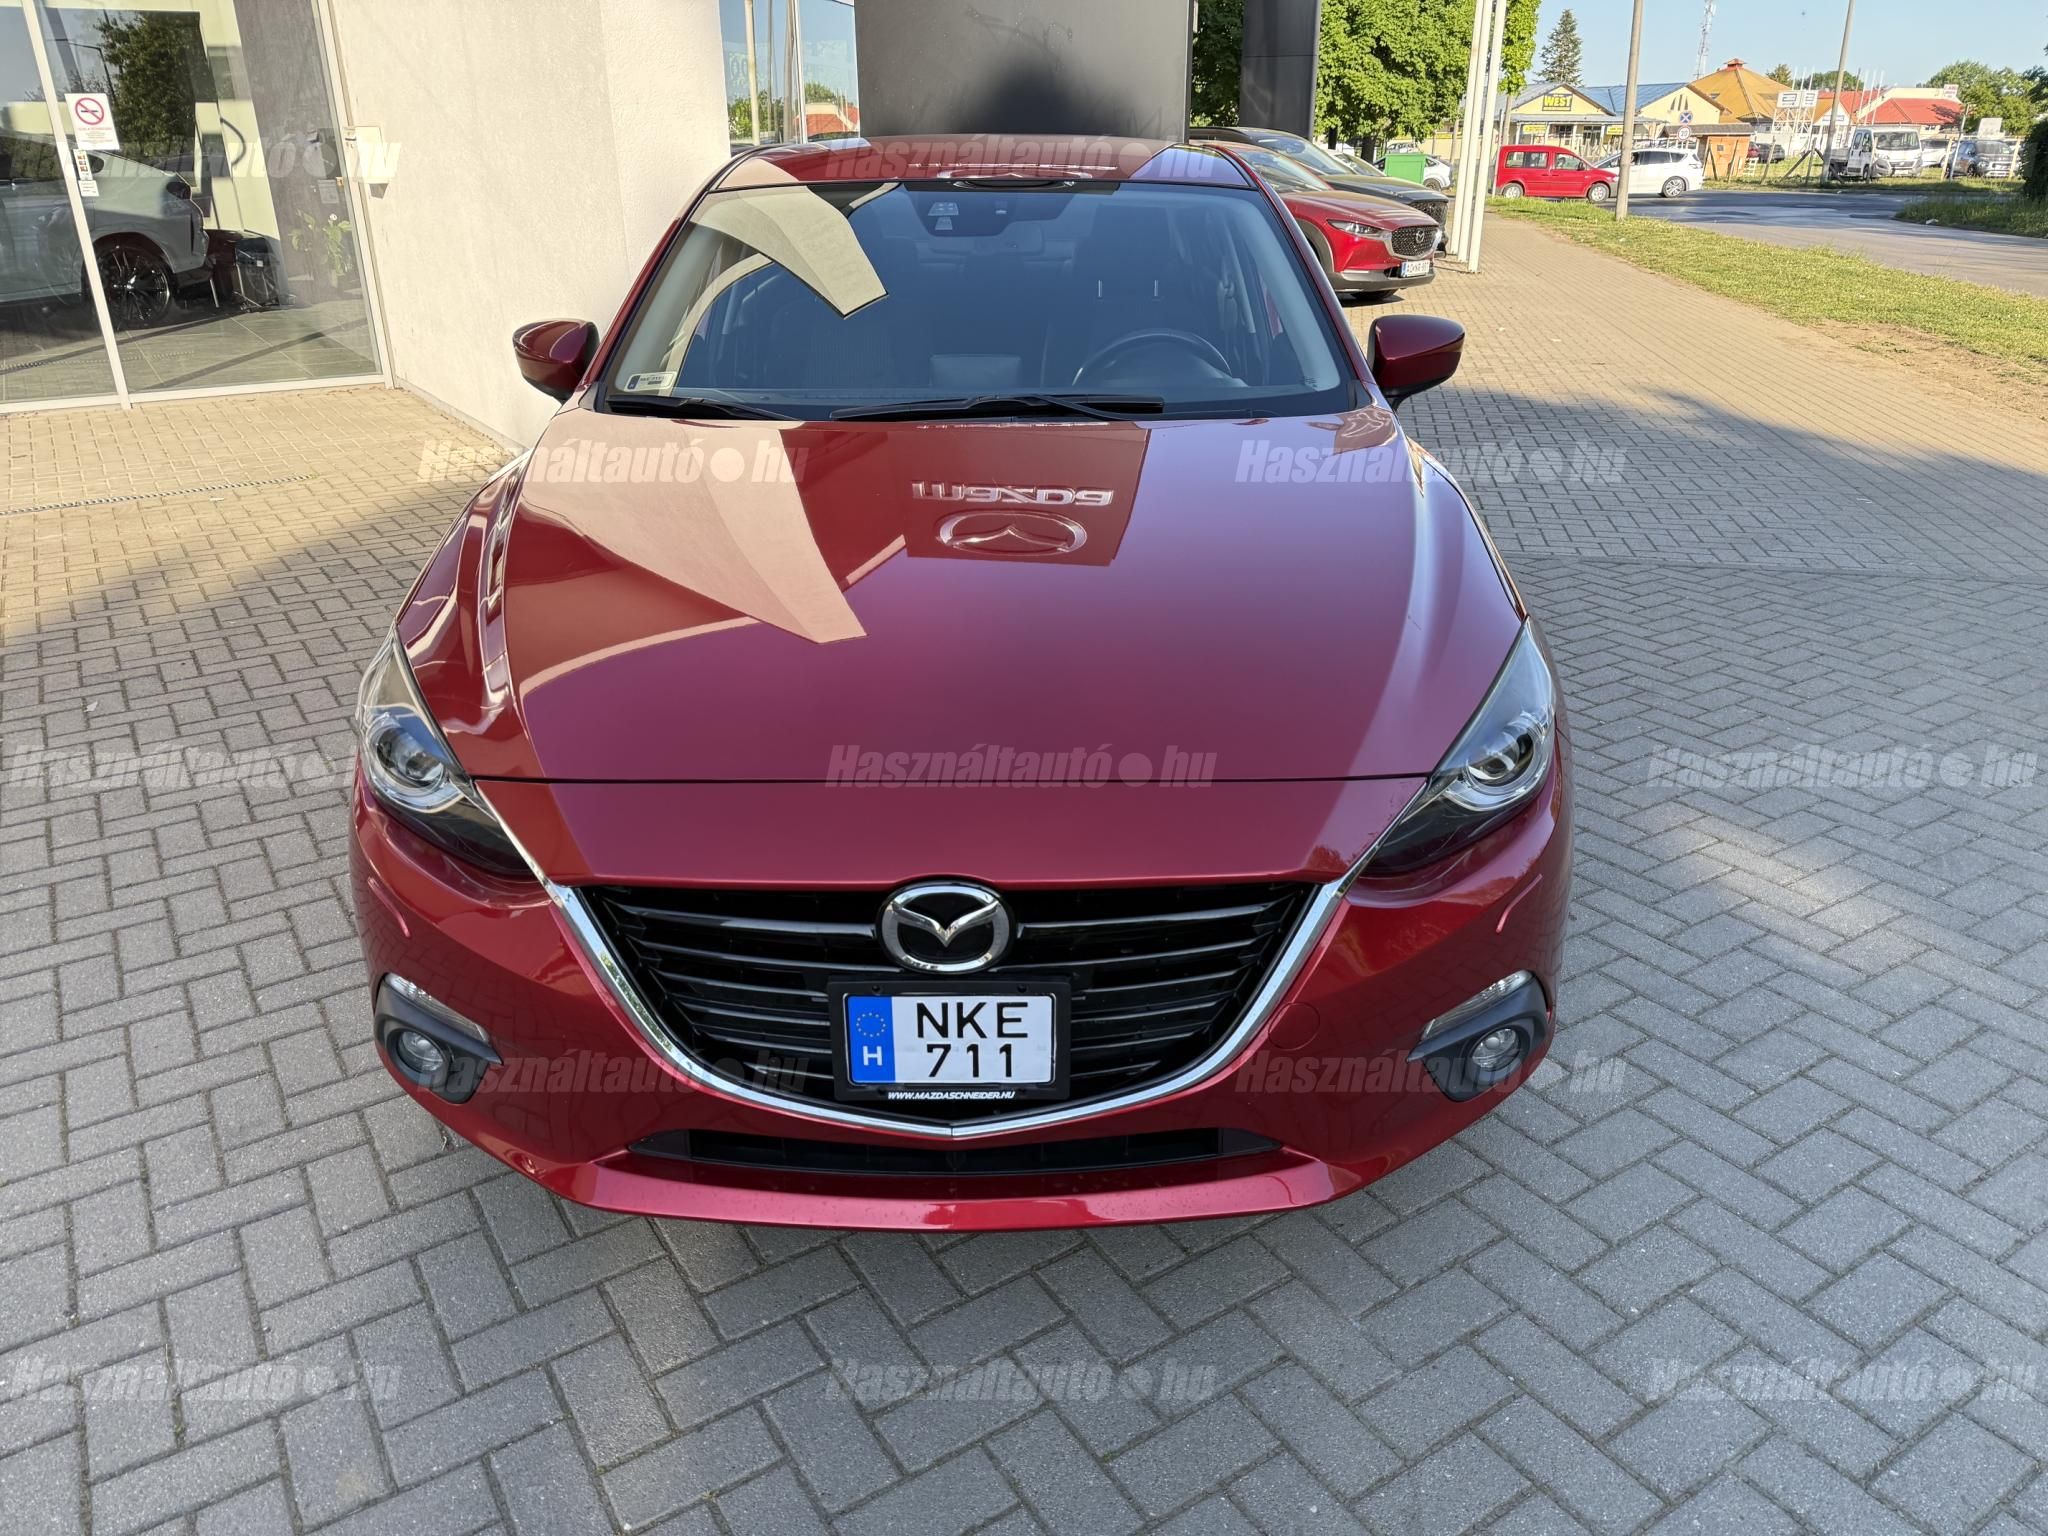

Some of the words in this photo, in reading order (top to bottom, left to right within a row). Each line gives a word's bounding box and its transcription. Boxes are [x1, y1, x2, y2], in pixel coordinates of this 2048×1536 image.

[1544, 95, 1572, 107] WEST
[917, 1002, 1028, 1038] NKE
[863, 1046, 883, 1066] H
[927, 1044, 1012, 1078] 711
[888, 1091, 1016, 1100] WWW.MAZDASCHNEIDER.HU
